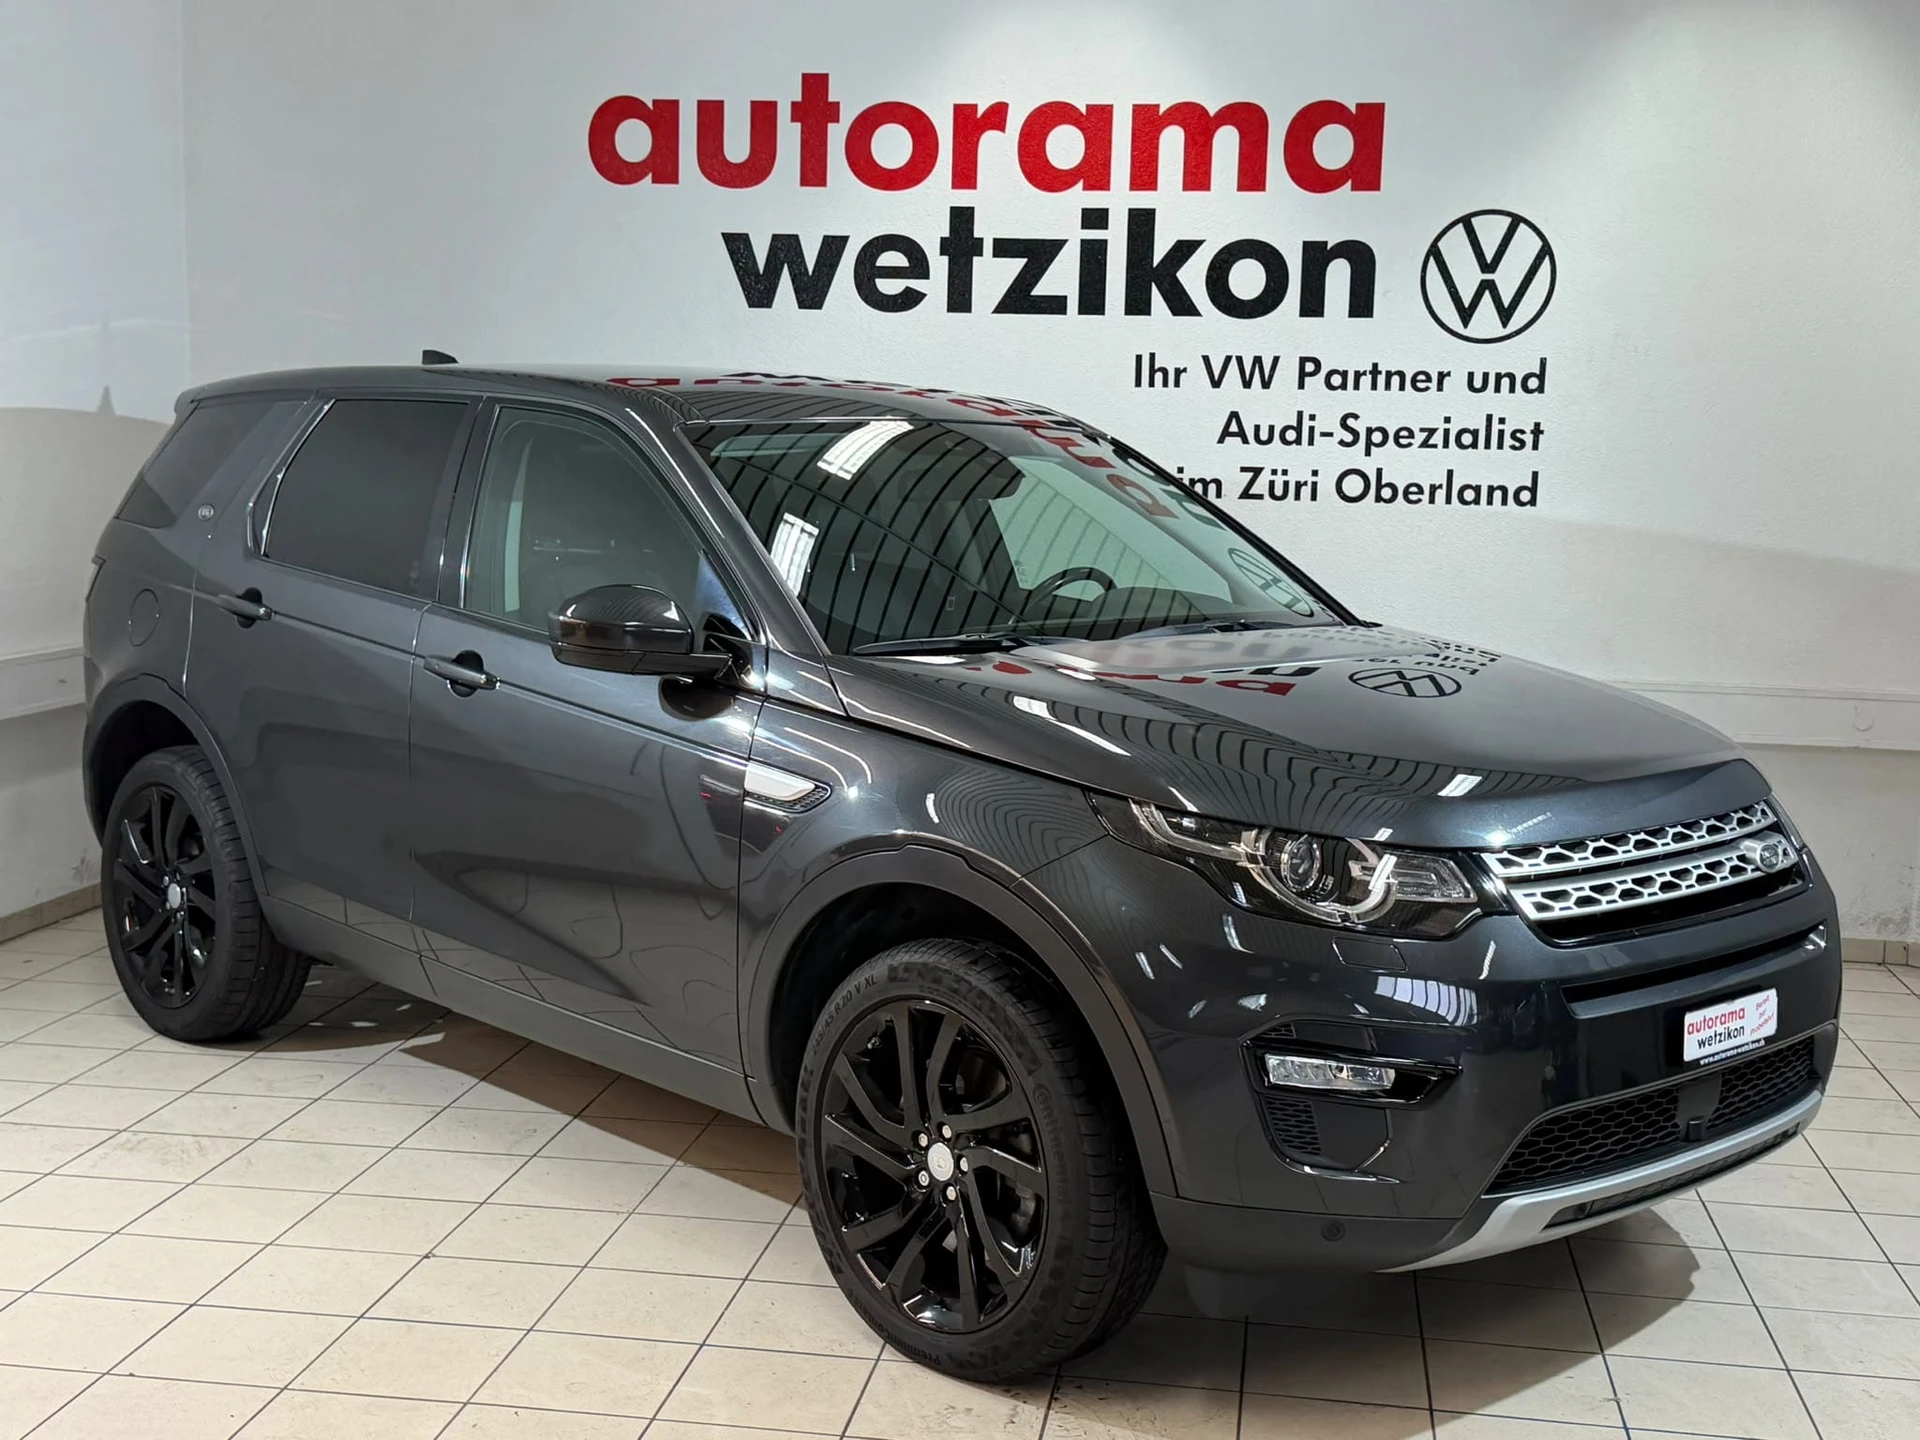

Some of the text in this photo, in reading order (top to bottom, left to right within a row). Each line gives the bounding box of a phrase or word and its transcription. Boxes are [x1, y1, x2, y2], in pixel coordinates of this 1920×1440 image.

[588, 73, 1386, 194] autorama
[720, 205, 1377, 320] wetzikon
[1134, 352, 1547, 395] Ihr VW Partner und
[1216, 410, 1545, 457] Audi-Spezialist
[1237, 466, 1319, 502] Züri
[1335, 467, 1539, 507] Oberland
[864, 973, 879, 989] XL
[1687, 1007, 1746, 1036] autorama
[1697, 1025, 1745, 1050] wetzikon
